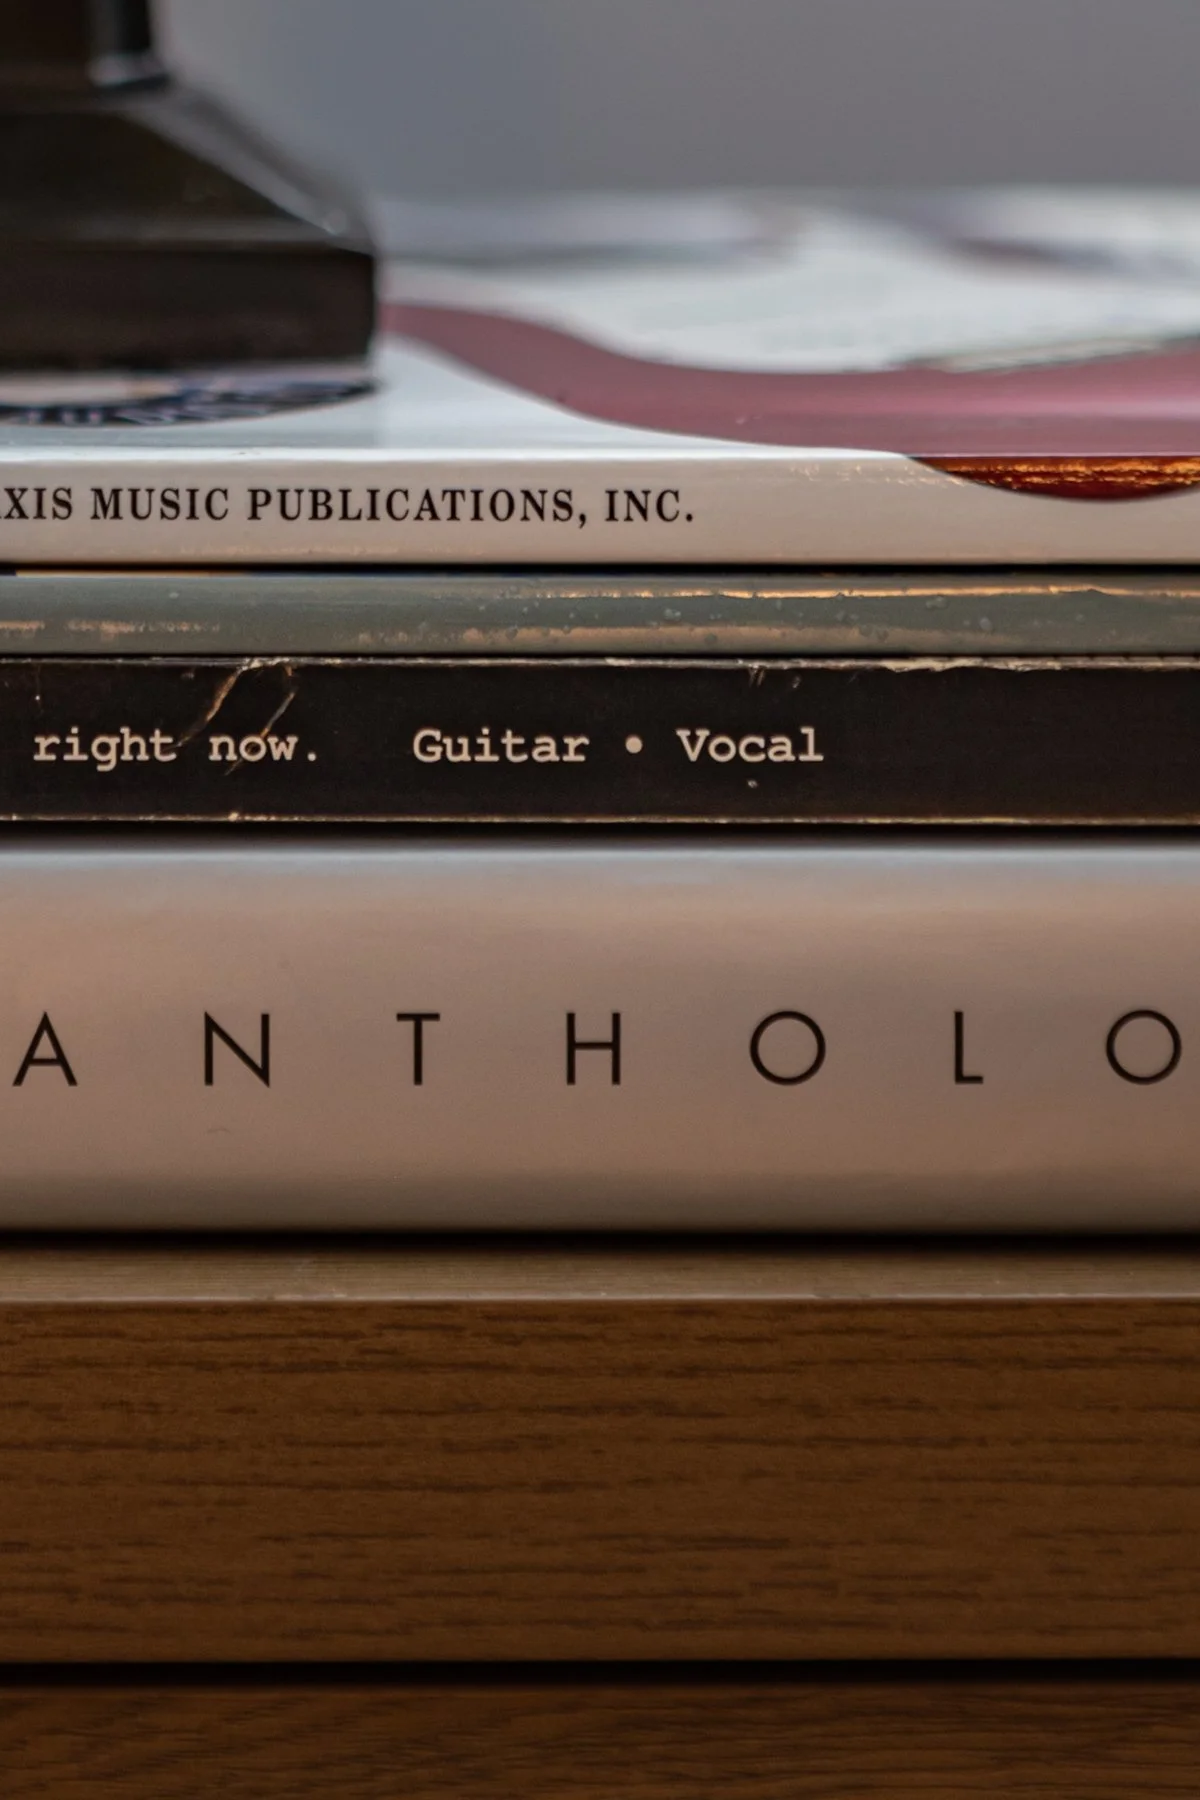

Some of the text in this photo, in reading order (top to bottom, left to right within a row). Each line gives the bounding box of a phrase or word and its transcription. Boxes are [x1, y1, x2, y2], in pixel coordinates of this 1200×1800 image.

[89, 487, 231, 522] MUSIC
[246, 488, 588, 528] PUBLICATIONS,
[604, 490, 695, 523] INC.
[33, 726, 177, 772] right
[208, 734, 319, 762] now.
[412, 727, 589, 764] Guitar
[676, 727, 825, 763] Vocal
